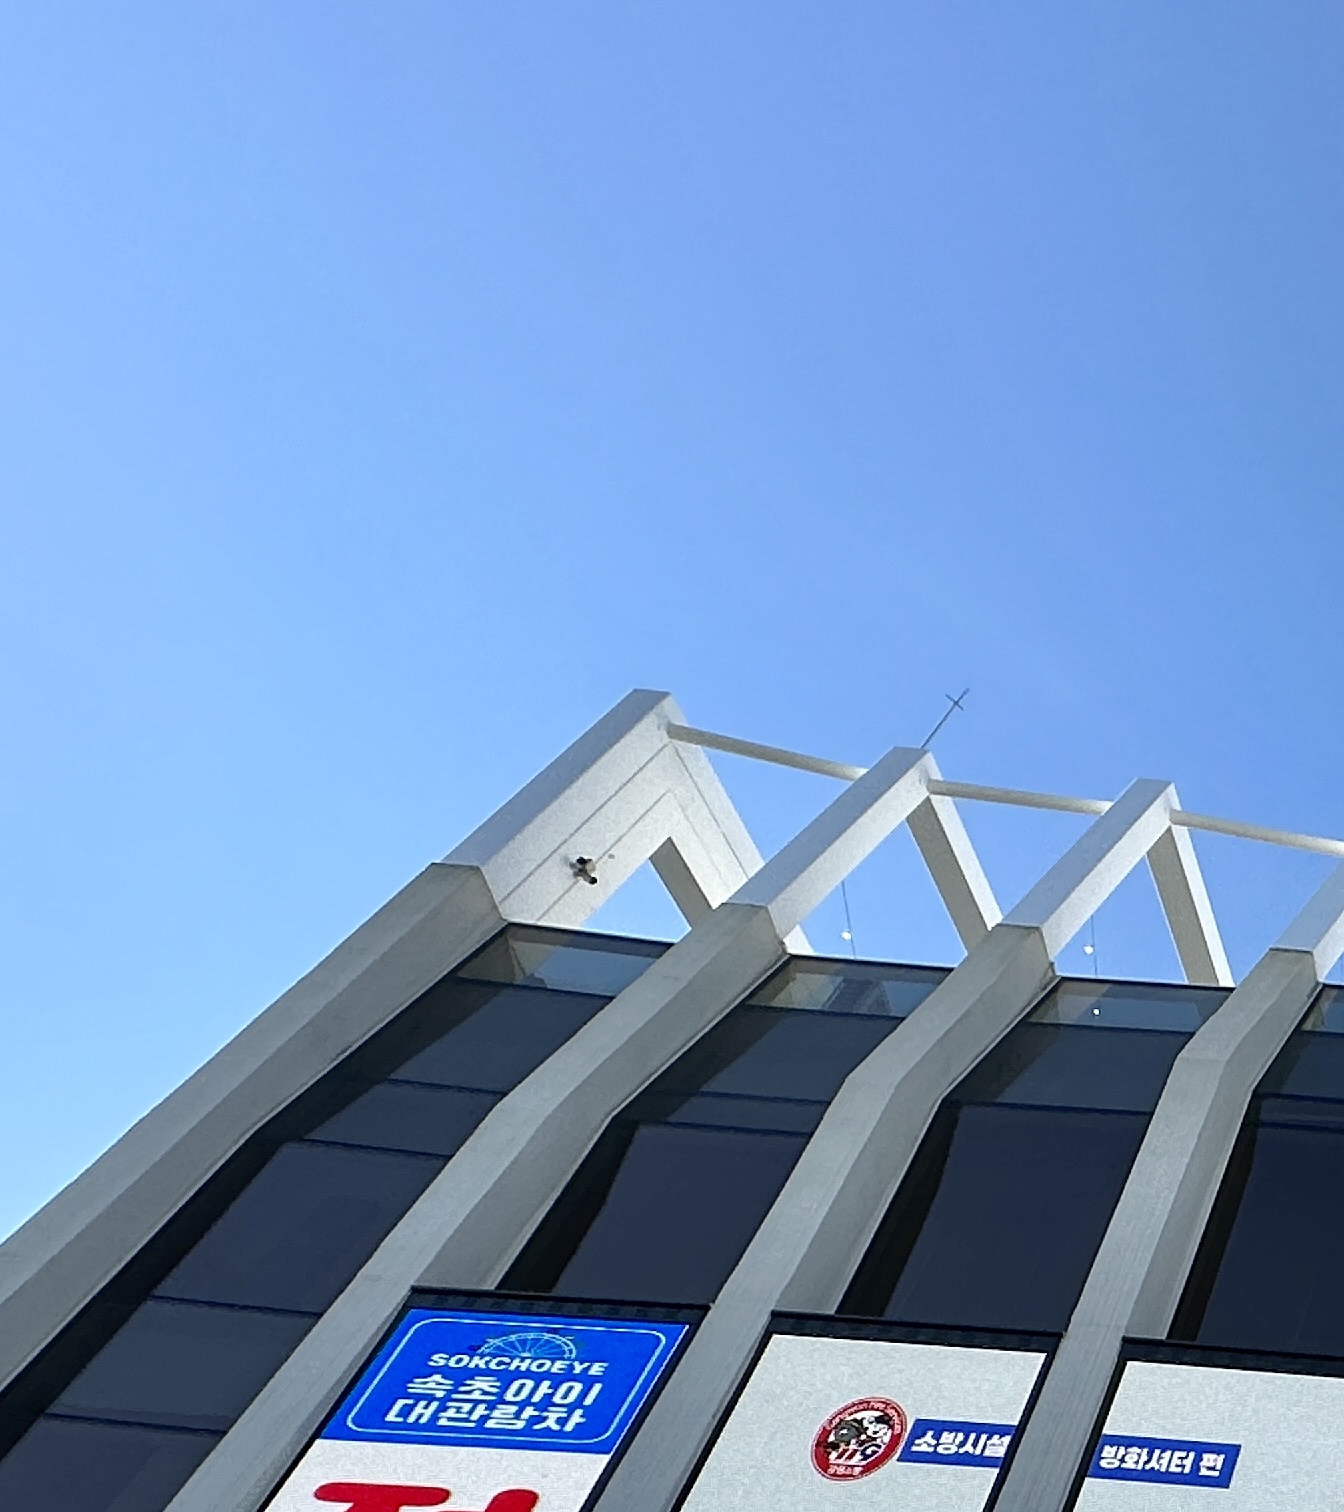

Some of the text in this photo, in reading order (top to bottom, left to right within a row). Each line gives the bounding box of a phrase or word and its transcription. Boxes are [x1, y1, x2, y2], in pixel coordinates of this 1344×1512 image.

[427, 1352, 610, 1377] SOKCHOEYE
[407, 1375, 602, 1406] 속초아이
[385, 1400, 587, 1432] 대관람차
[1100, 1444, 1196, 1474] 방화셔터
[1199, 1452, 1227, 1478] 편
